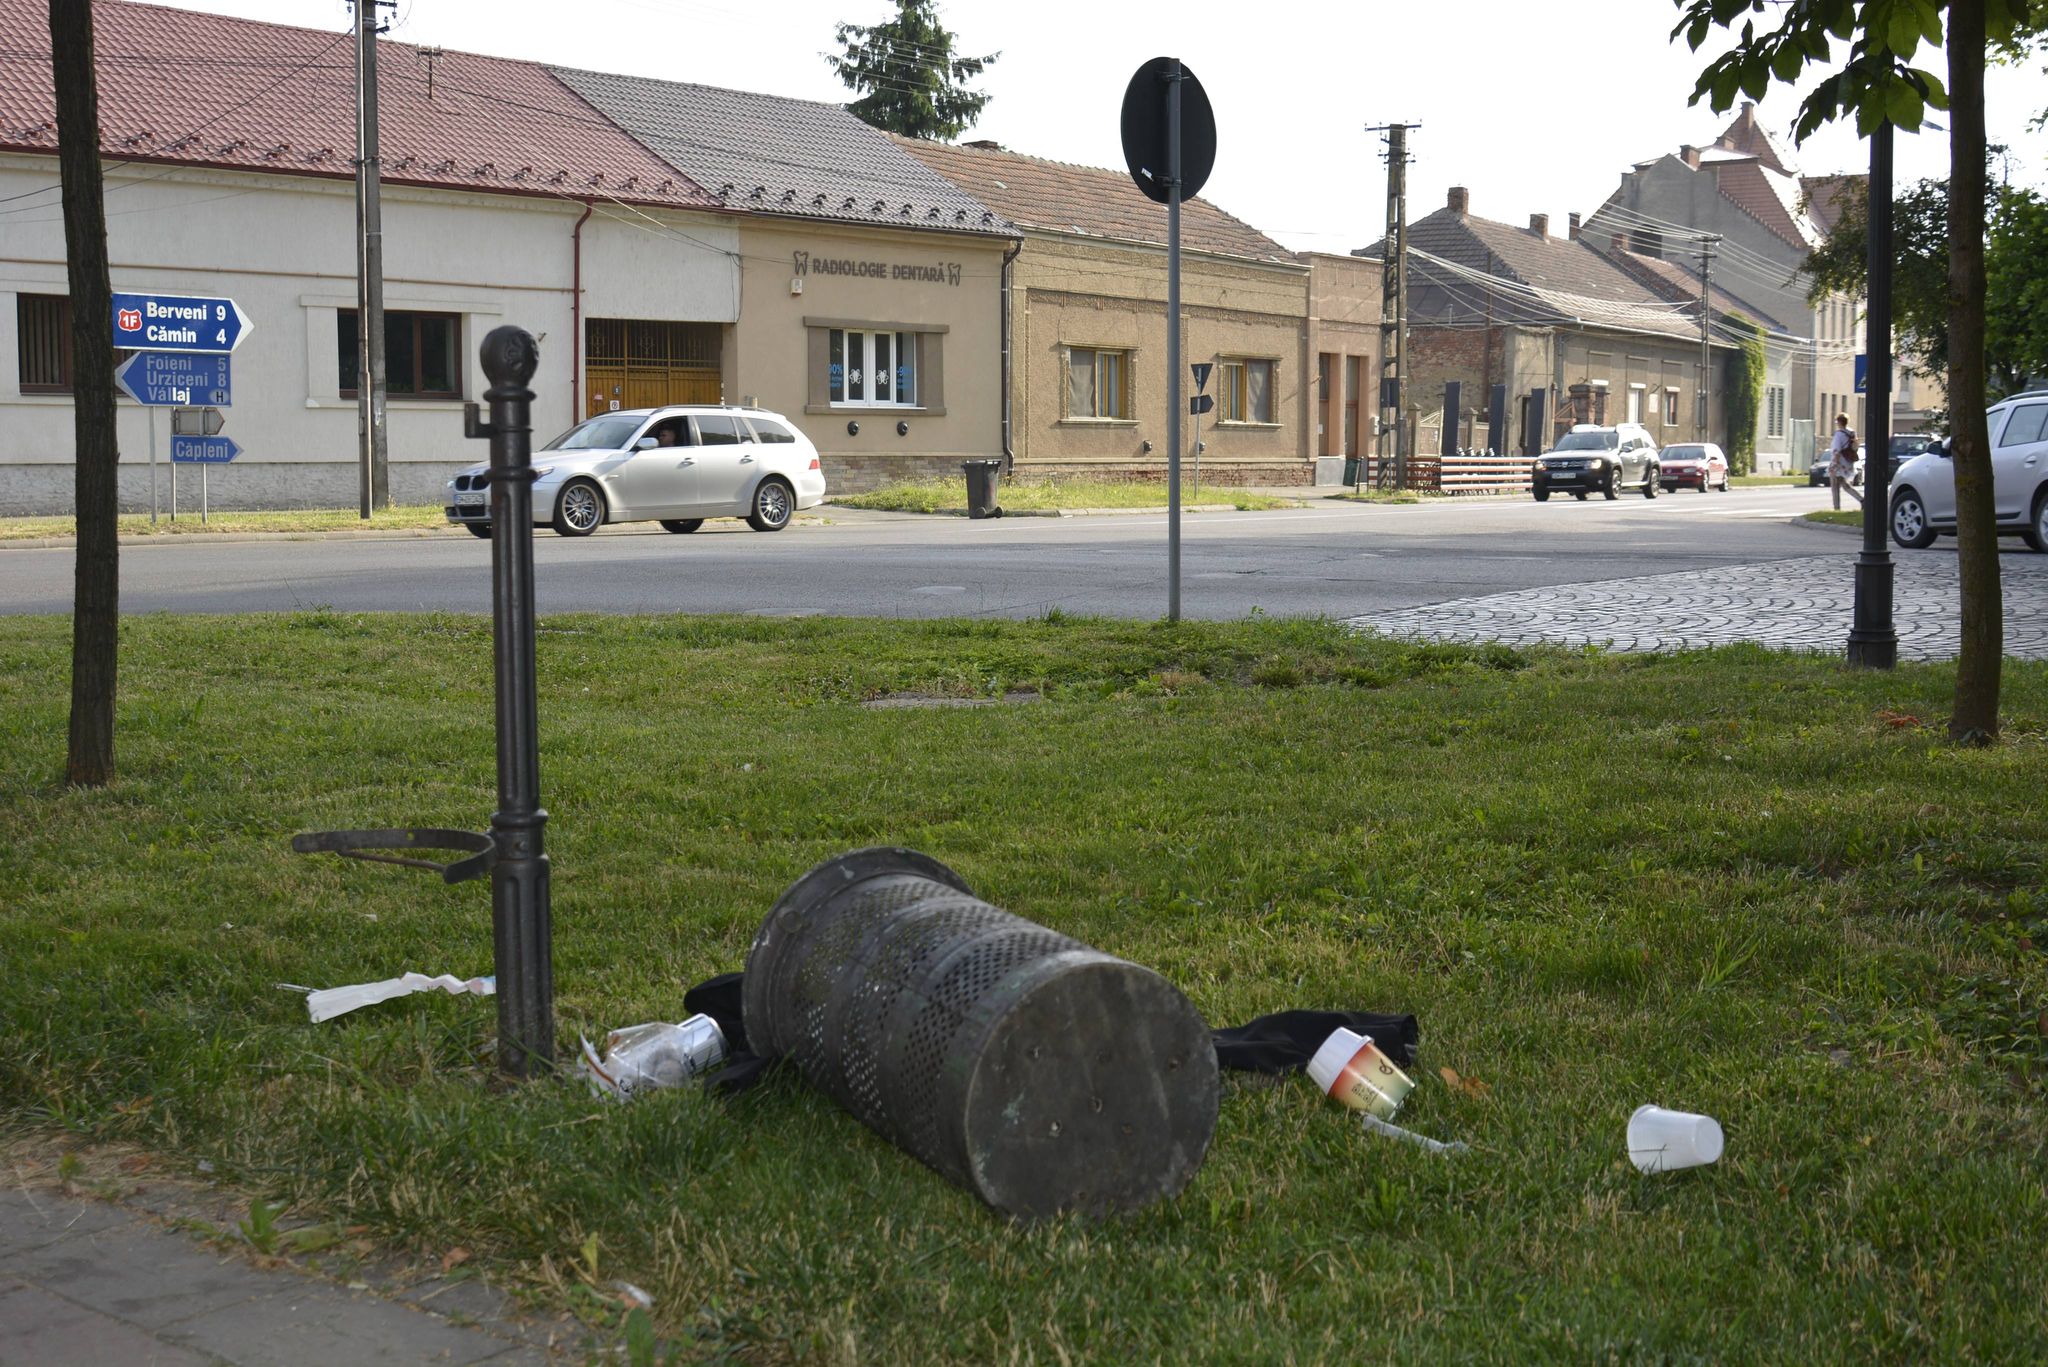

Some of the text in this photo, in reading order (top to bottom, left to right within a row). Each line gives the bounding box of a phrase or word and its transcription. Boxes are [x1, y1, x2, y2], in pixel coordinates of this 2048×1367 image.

[812, 258, 946, 283] RADIOLOGIE DENTARĂ
[146, 301, 226, 321] Berveni 9
[122, 315, 138, 328] 1F
[146, 325, 227, 344] Cămin 4
[146, 355, 226, 371] Foieni 5
[146, 371, 227, 387] Urziceni 8
[147, 386, 224, 405] Vállaj H
[176, 441, 228, 460] Căpleni
